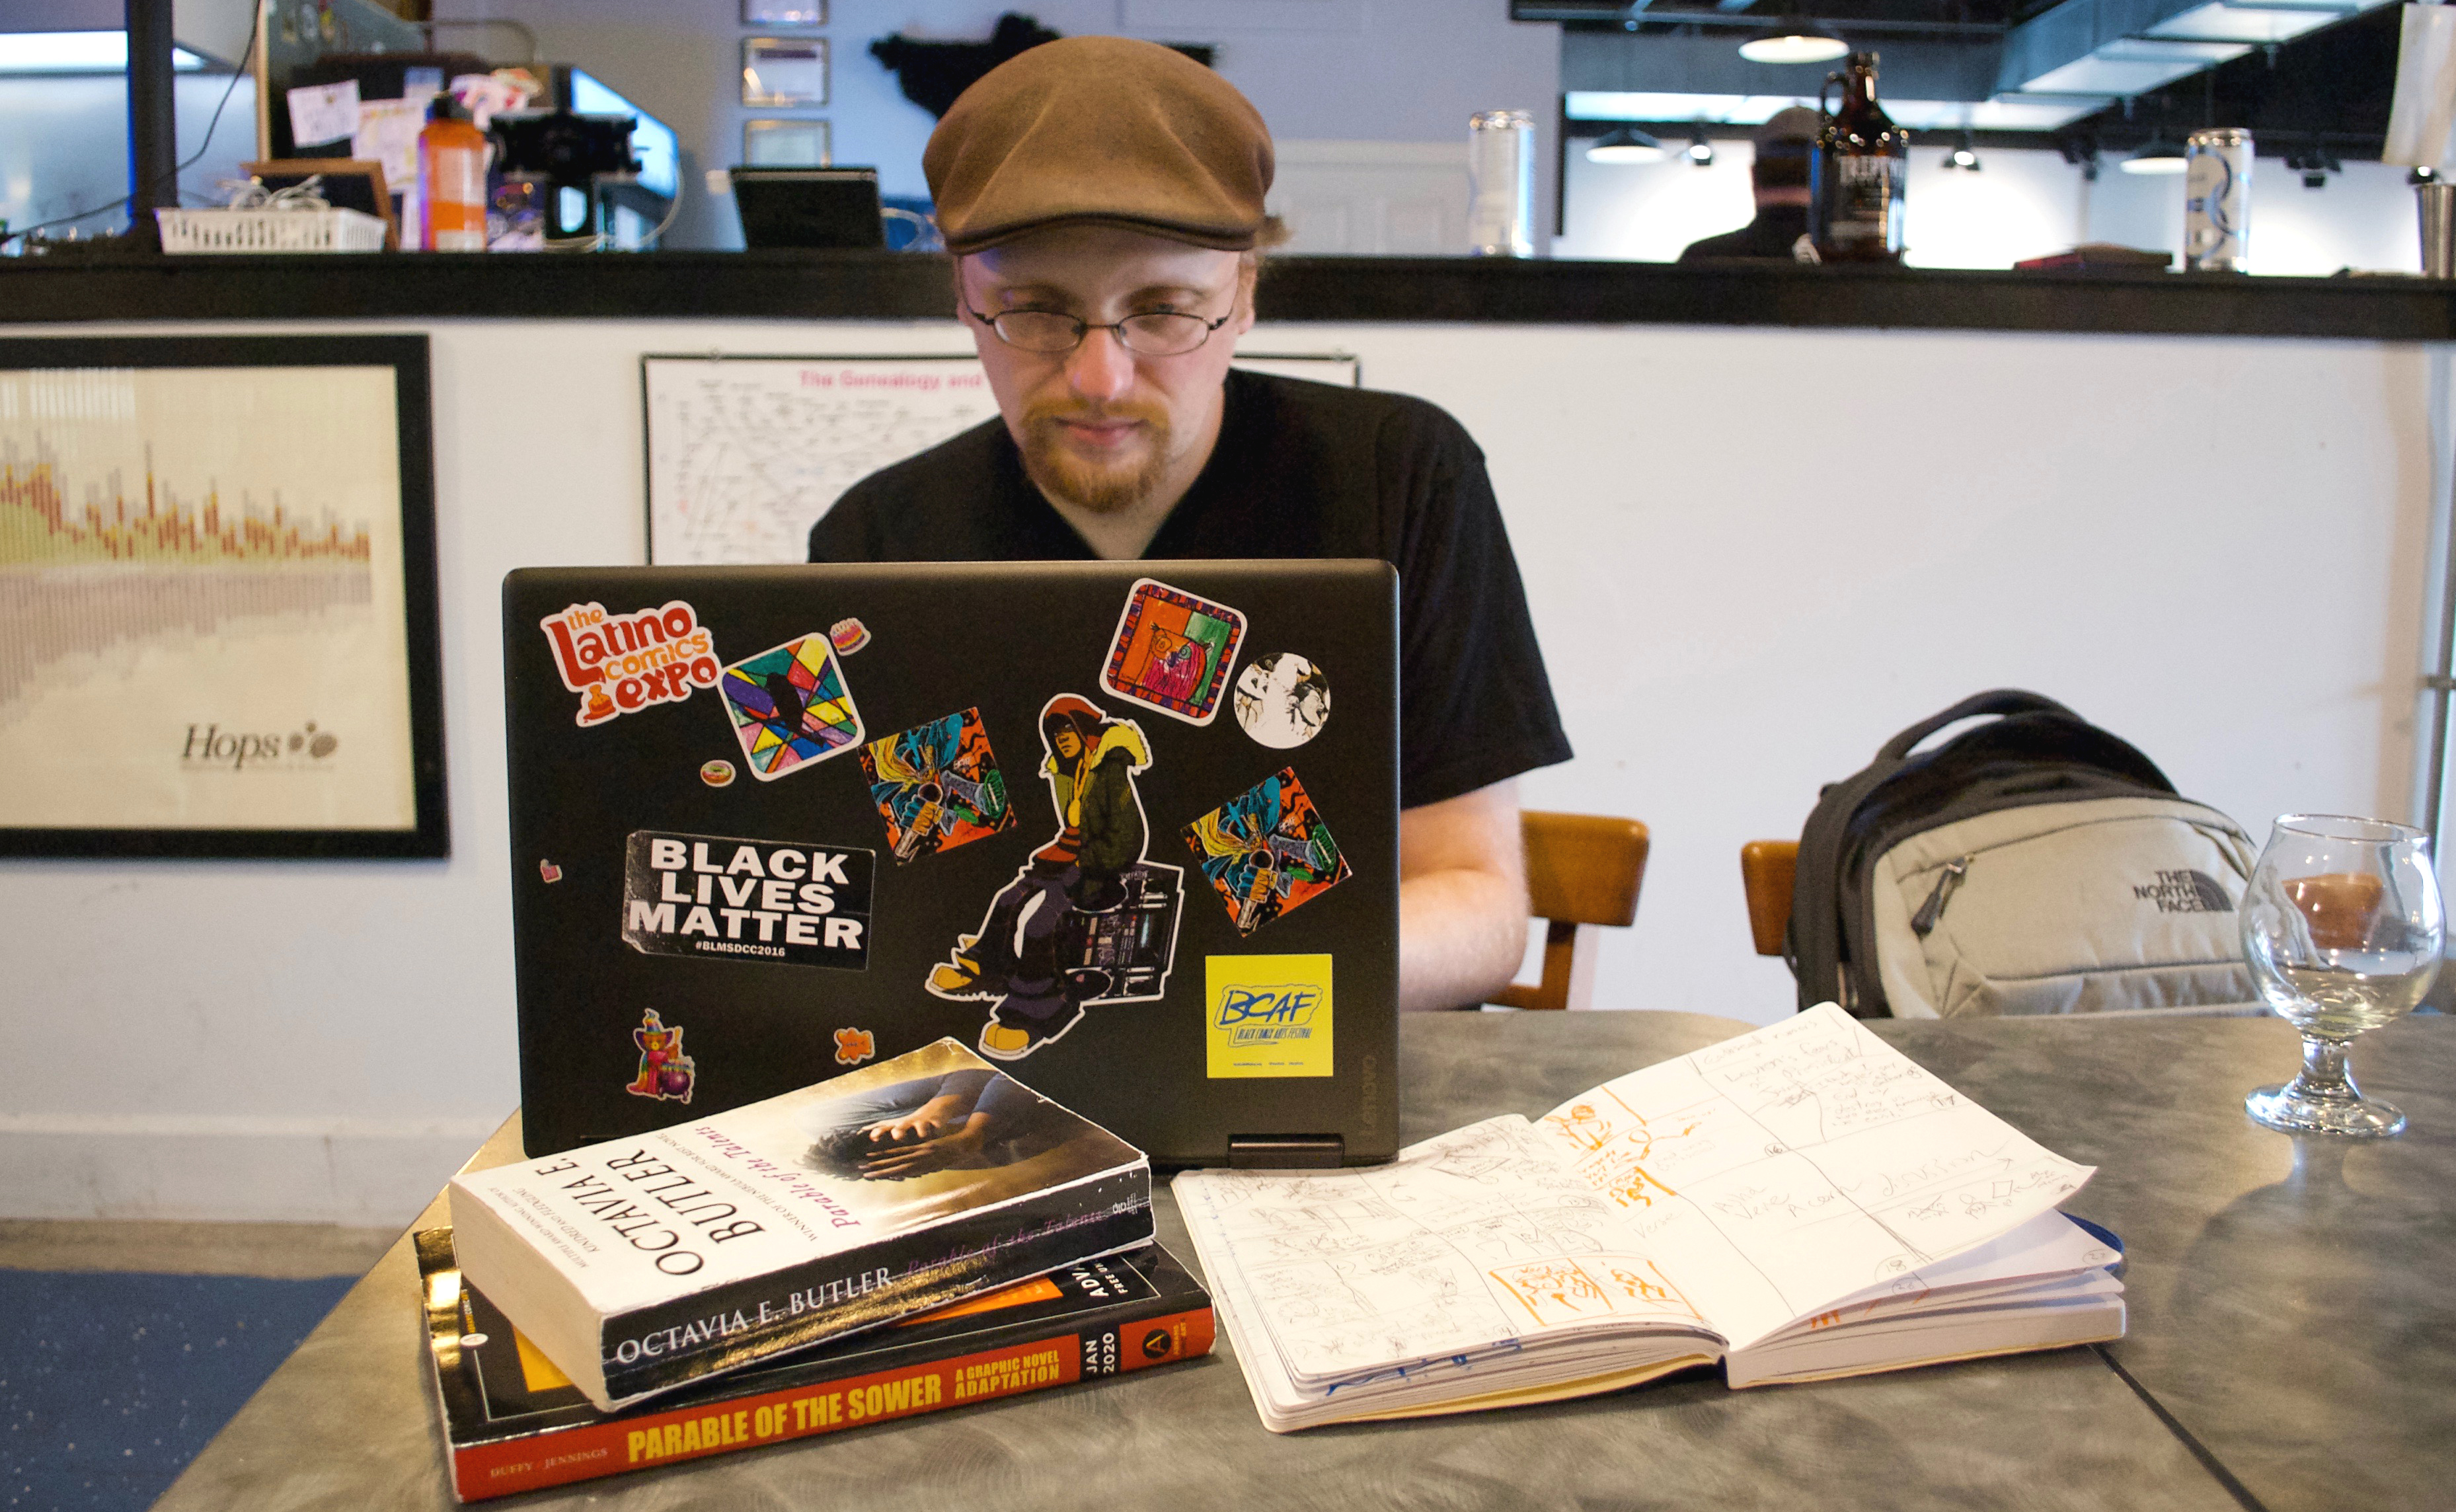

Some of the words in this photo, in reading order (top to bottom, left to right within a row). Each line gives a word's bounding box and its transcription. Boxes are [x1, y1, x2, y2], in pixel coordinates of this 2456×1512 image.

[800, 370, 832, 387] The
[839, 370, 941, 391] Genealogy
[568, 607, 604, 631] the
[604, 632, 709, 681] comics
[615, 656, 718, 708] expo
[182, 722, 282, 771] Hops
[650, 839, 849, 885] BLACK
[2155, 869, 2191, 885] THE
[662, 871, 835, 914] LIVES
[2133, 884, 2198, 899] NORTH
[2157, 898, 2204, 913] FACE
[629, 900, 864, 950] MATTER
[695, 941, 786, 958] #BLMSDCC2016
[1219, 990, 1317, 1025] BCAF
[695, 1127, 751, 1158] Talents
[535, 1158, 579, 1176] E.
[747, 1158, 778, 1172] the
[762, 1173, 802, 1182] of
[607, 1149, 765, 1244] BUTLER
[755, 1194, 775, 1205] THE
[790, 1184, 861, 1228] Parable
[560, 1226, 600, 1253] KINDRED
[562, 1175, 704, 1275] OCTAVIA
[783, 1212, 818, 1242] WINNER
[1104, 1273, 1128, 1293] FREE
[617, 1310, 750, 1365] OCTAVIA
[758, 1301, 781, 1324] E.
[789, 1266, 894, 1316] BUTLER
[956, 1369, 963, 1382] A
[967, 1358, 1020, 1380] GRAPHIC
[1022, 1349, 1059, 1371] NOVEL
[1086, 1340, 1097, 1374] JAN
[1102, 1332, 1116, 1375] 2020
[954, 1363, 1059, 1399] ADAPTATION
[627, 1410, 750, 1464] PARABLE
[755, 1402, 788, 1439] OF
[792, 1392, 843, 1431] THE
[849, 1373, 942, 1419] SOWER
[490, 1462, 533, 1478] DUFFY
[544, 1447, 608, 1469] JENNINGS
